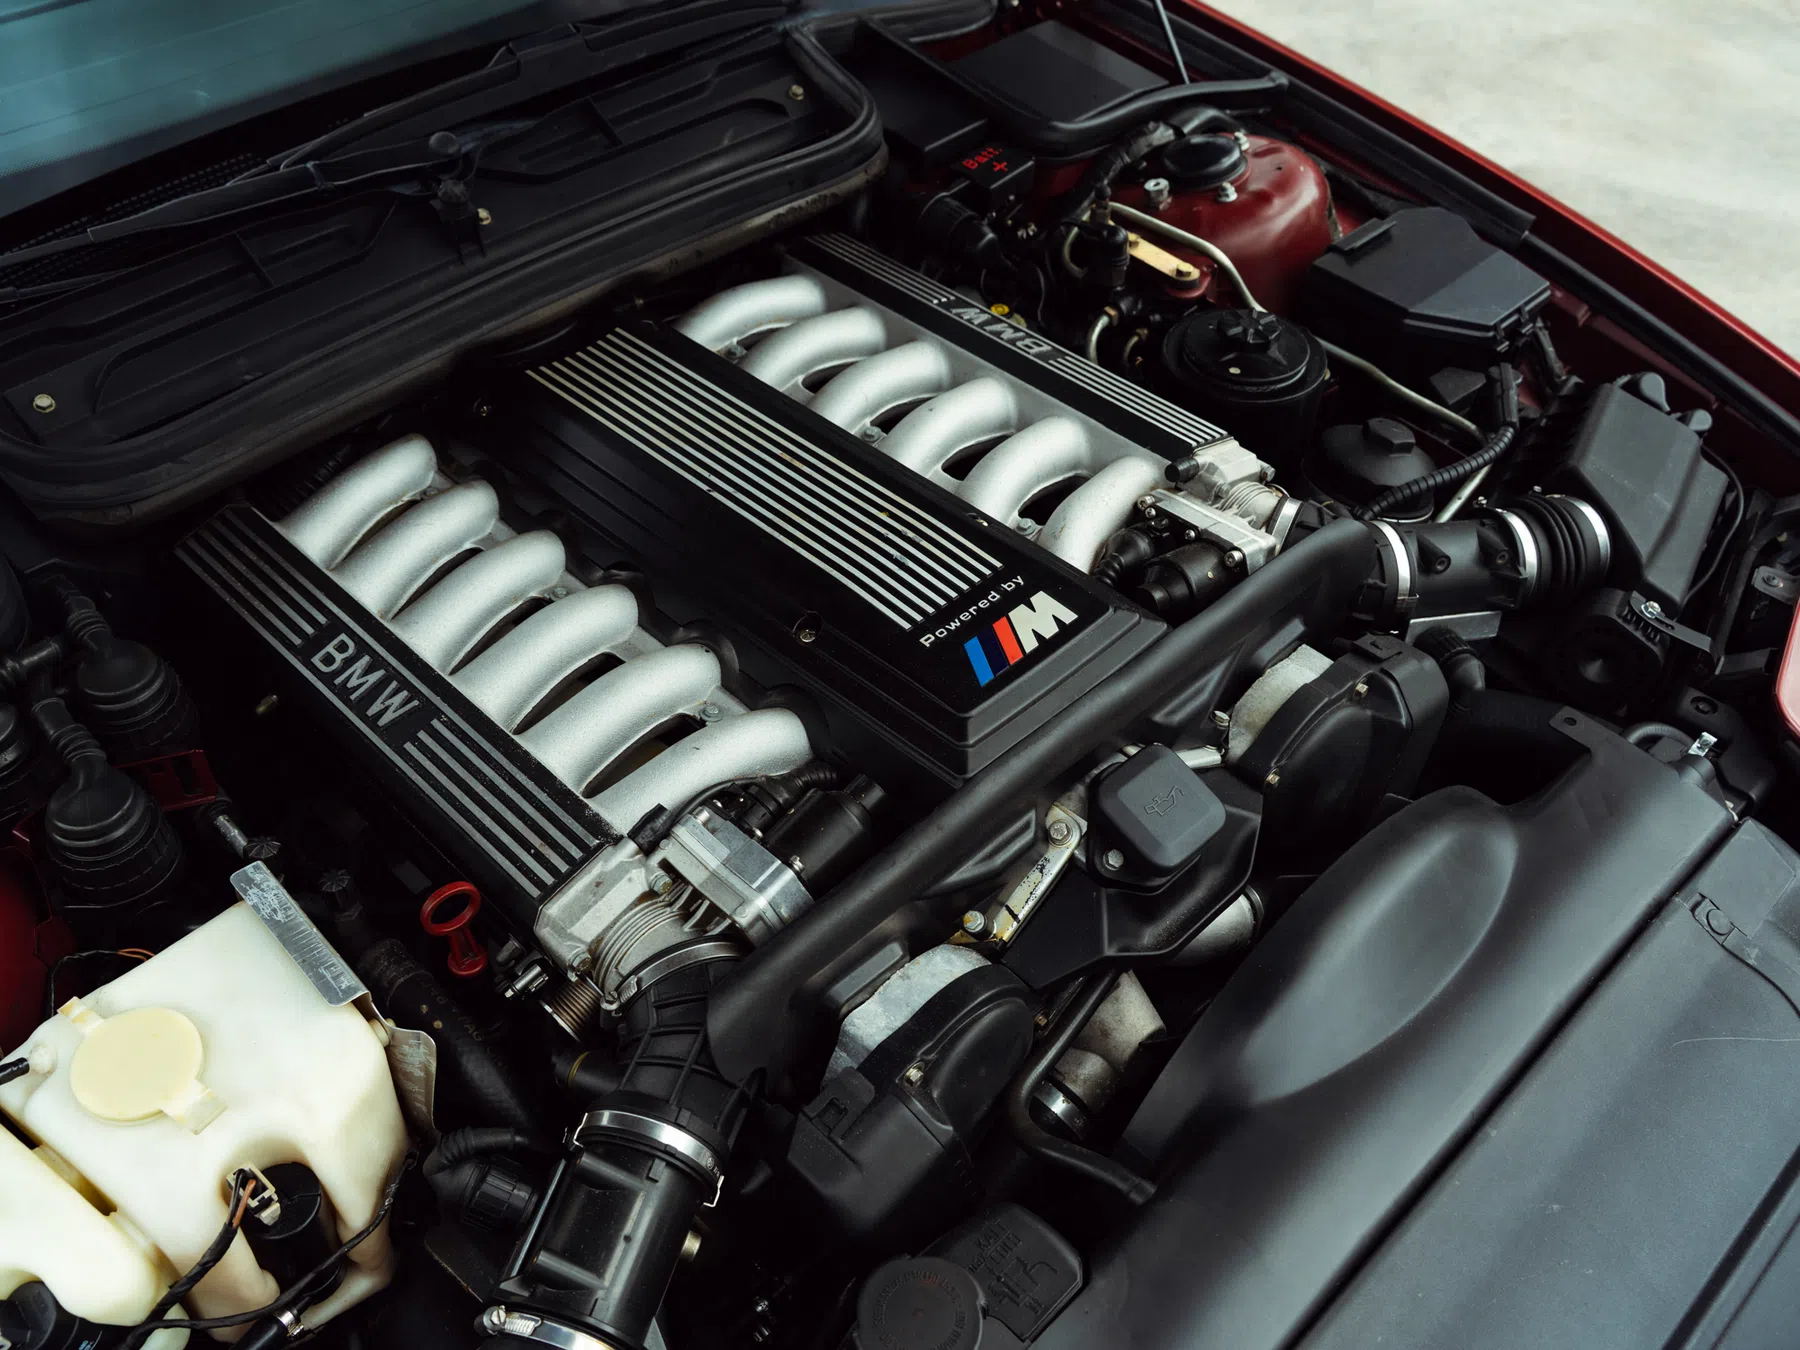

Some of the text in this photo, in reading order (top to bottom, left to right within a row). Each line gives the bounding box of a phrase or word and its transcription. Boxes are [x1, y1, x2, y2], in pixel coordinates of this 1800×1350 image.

[951, 307, 1052, 355] BMW
[919, 575, 1025, 648] Powered by
[1008, 590, 1079, 654] M
[310, 631, 420, 727] BMW
